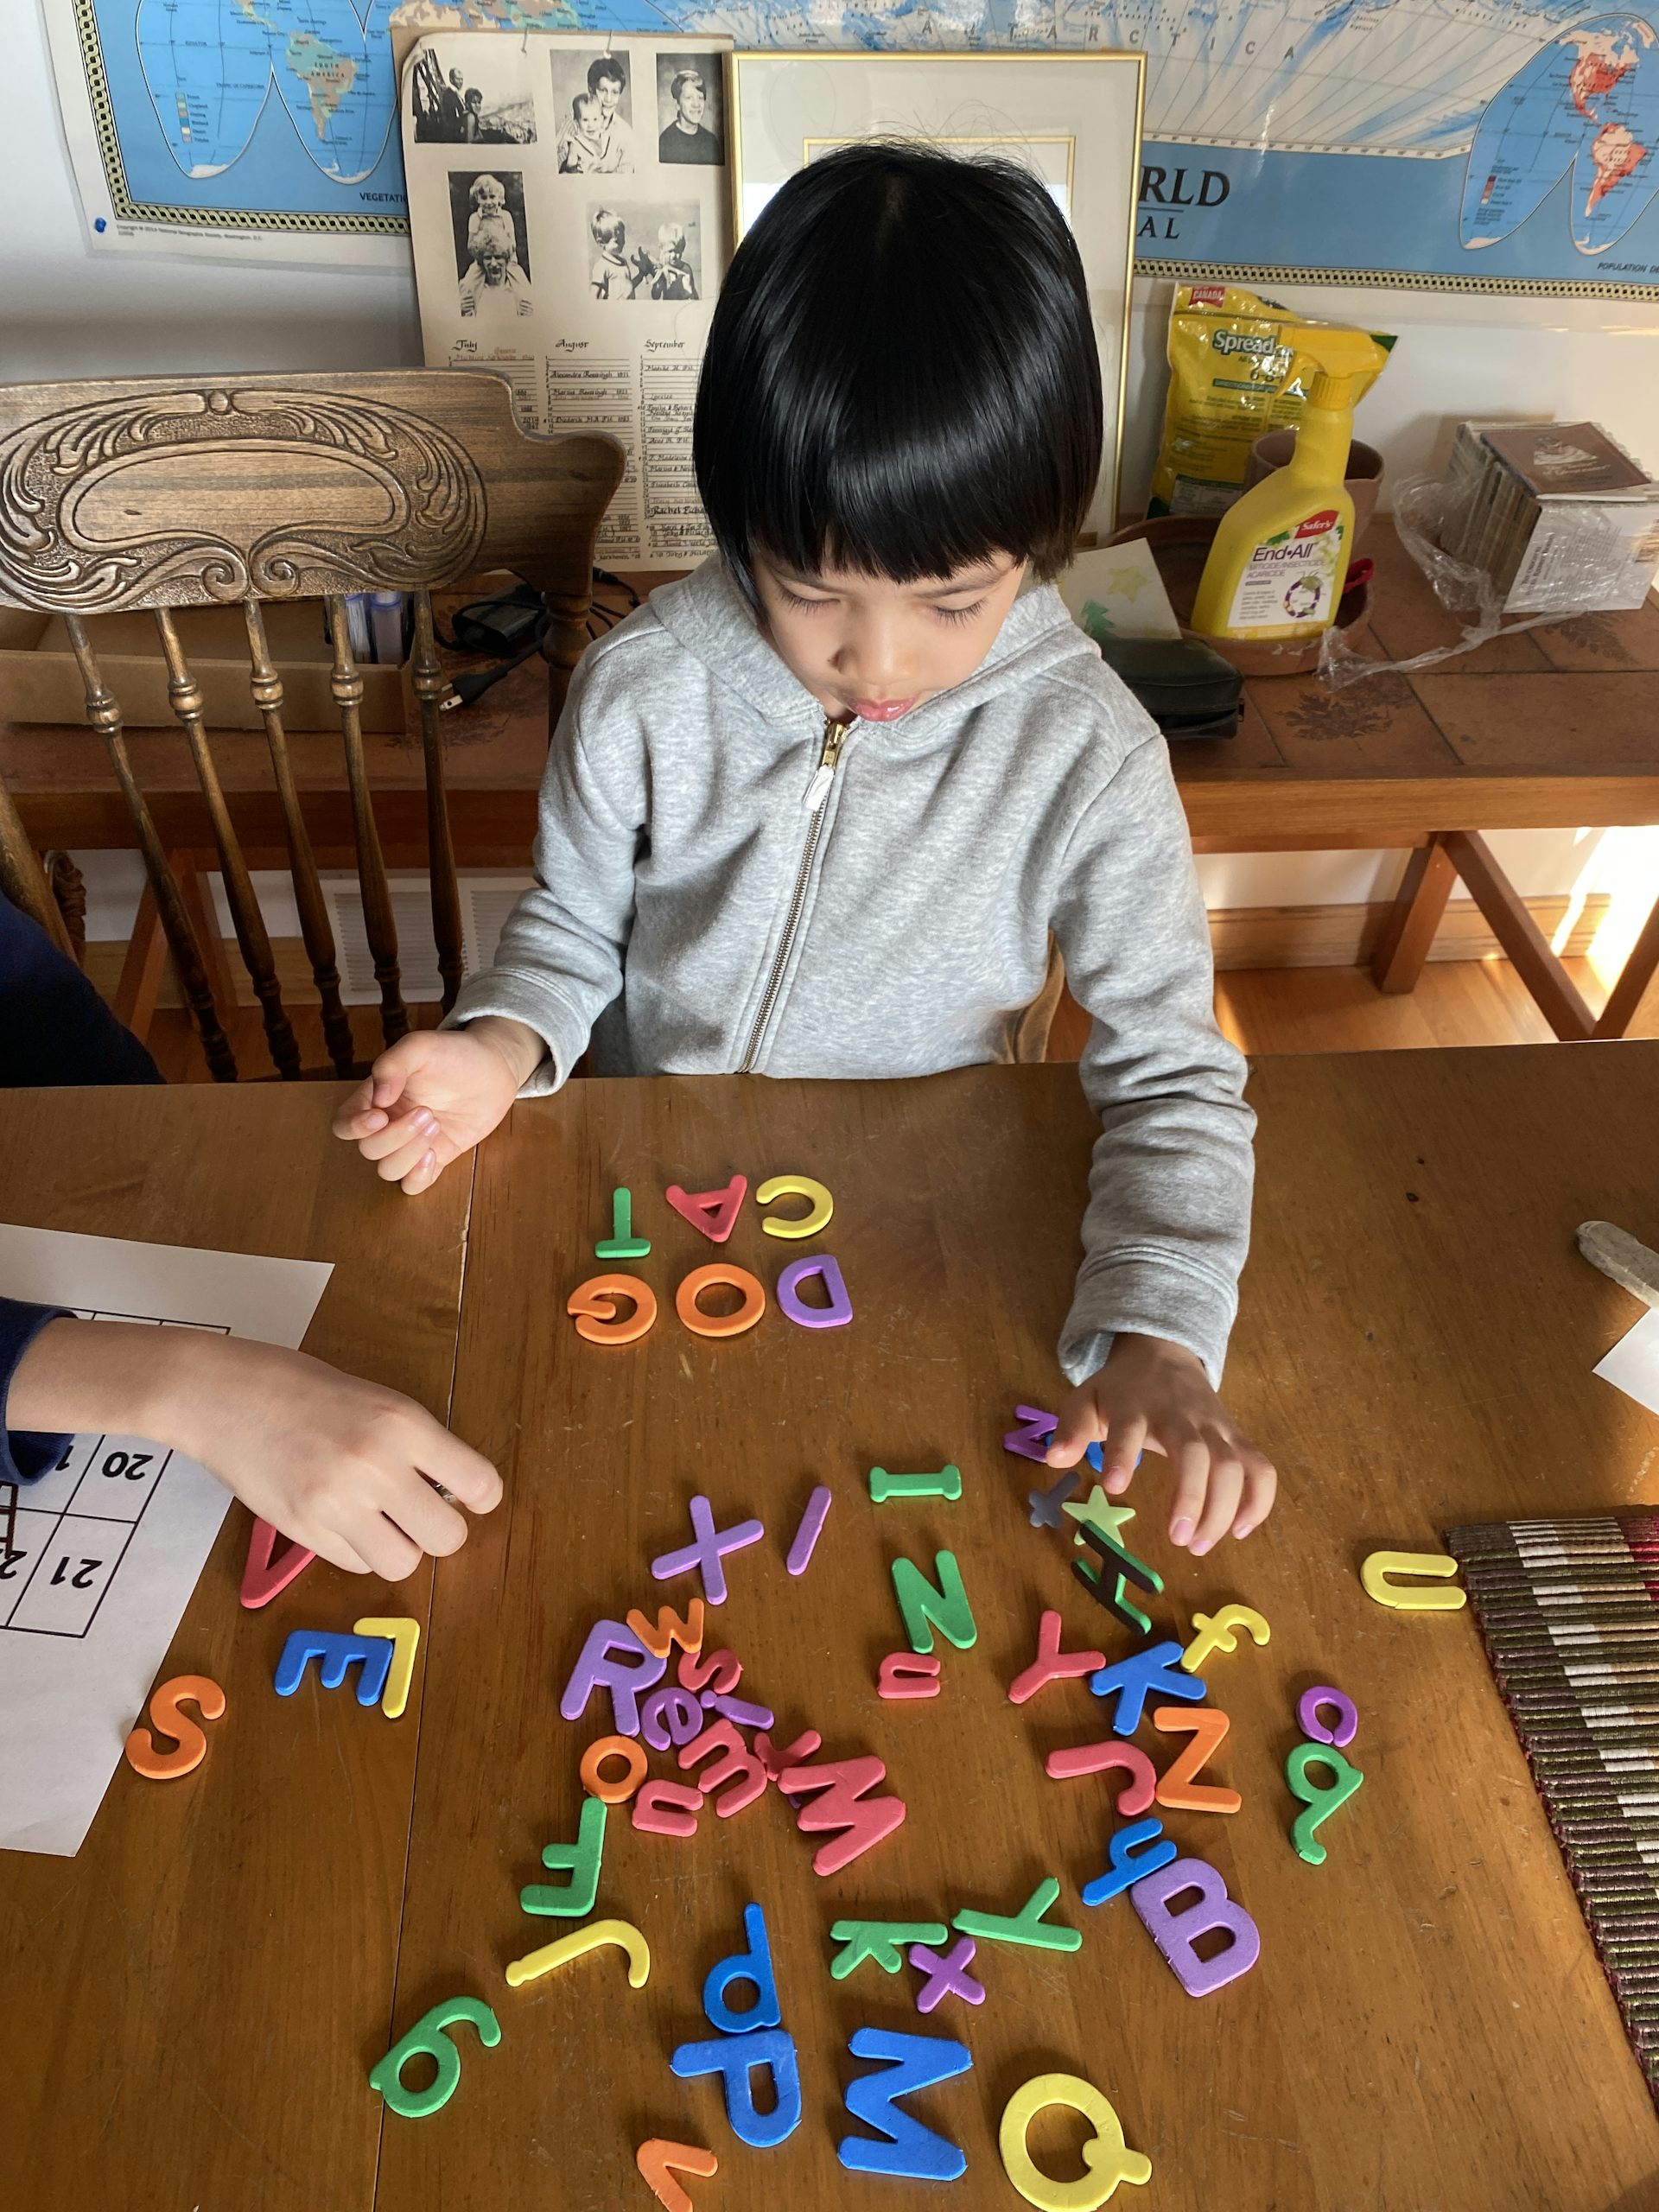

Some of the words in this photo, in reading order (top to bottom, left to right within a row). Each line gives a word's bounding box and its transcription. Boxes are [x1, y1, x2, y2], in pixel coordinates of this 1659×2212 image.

[1193, 289, 1224, 301] CANADA
[644, 339, 686, 353] September
[102, 1452, 154, 1481] 20
[49, 1556, 104, 1589] 21
